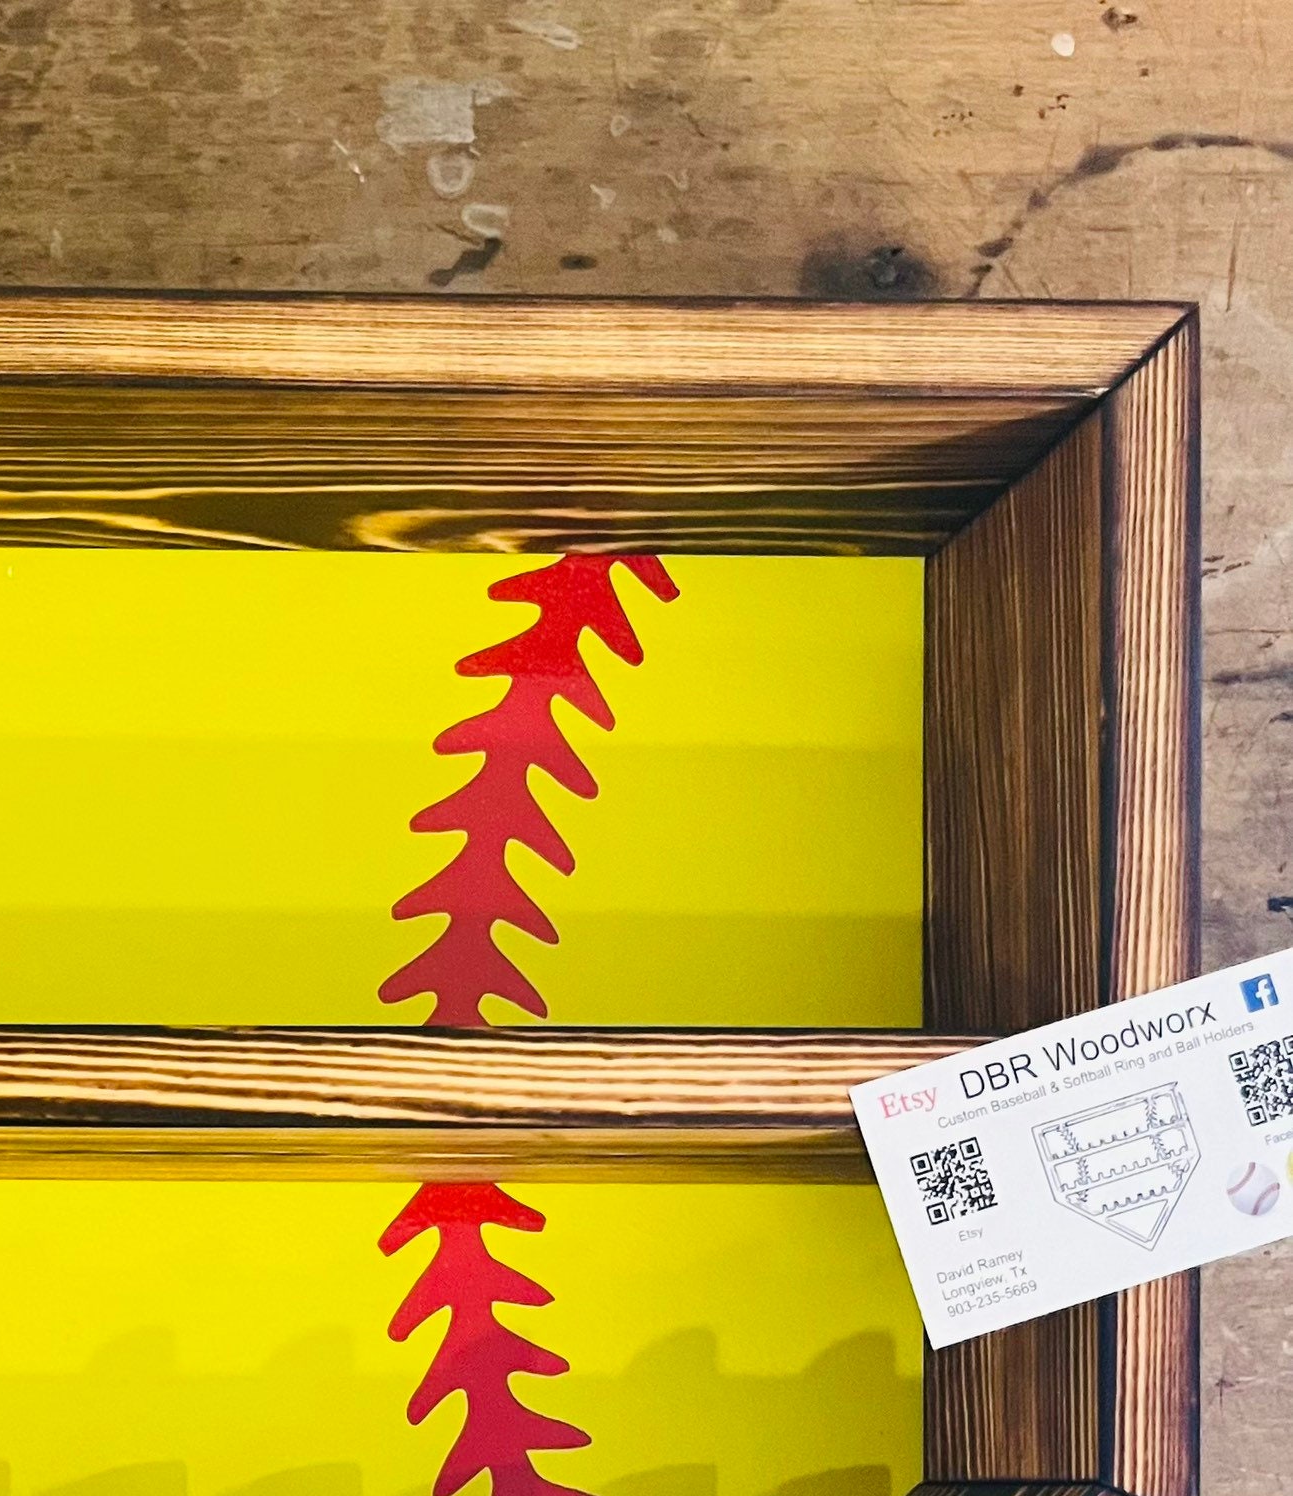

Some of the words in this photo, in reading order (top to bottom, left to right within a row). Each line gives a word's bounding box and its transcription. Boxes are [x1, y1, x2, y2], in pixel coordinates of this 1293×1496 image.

[960, 1052, 1038, 1100] DBR
[1042, 1002, 1217, 1072] Woodworx
[938, 1106, 989, 1129] Custom
[991, 1084, 1047, 1113] Baseball
[1050, 1081, 1060, 1094] &
[1062, 1062, 1111, 1090] Softball
[1114, 1057, 1146, 1075] Ring
[1148, 1046, 1173, 1063] and
[1175, 1036, 1201, 1053] Ball
[1204, 1020, 1255, 1045] Holders
[877, 1086, 938, 1120] Etsy
[958, 1227, 984, 1241] Etsy
[936, 1262, 974, 1284] David
[977, 1249, 1023, 1271] Ramey
[1010, 1266, 1028, 1278] Tx
[947, 1280, 1038, 1318] 903-235-5669
